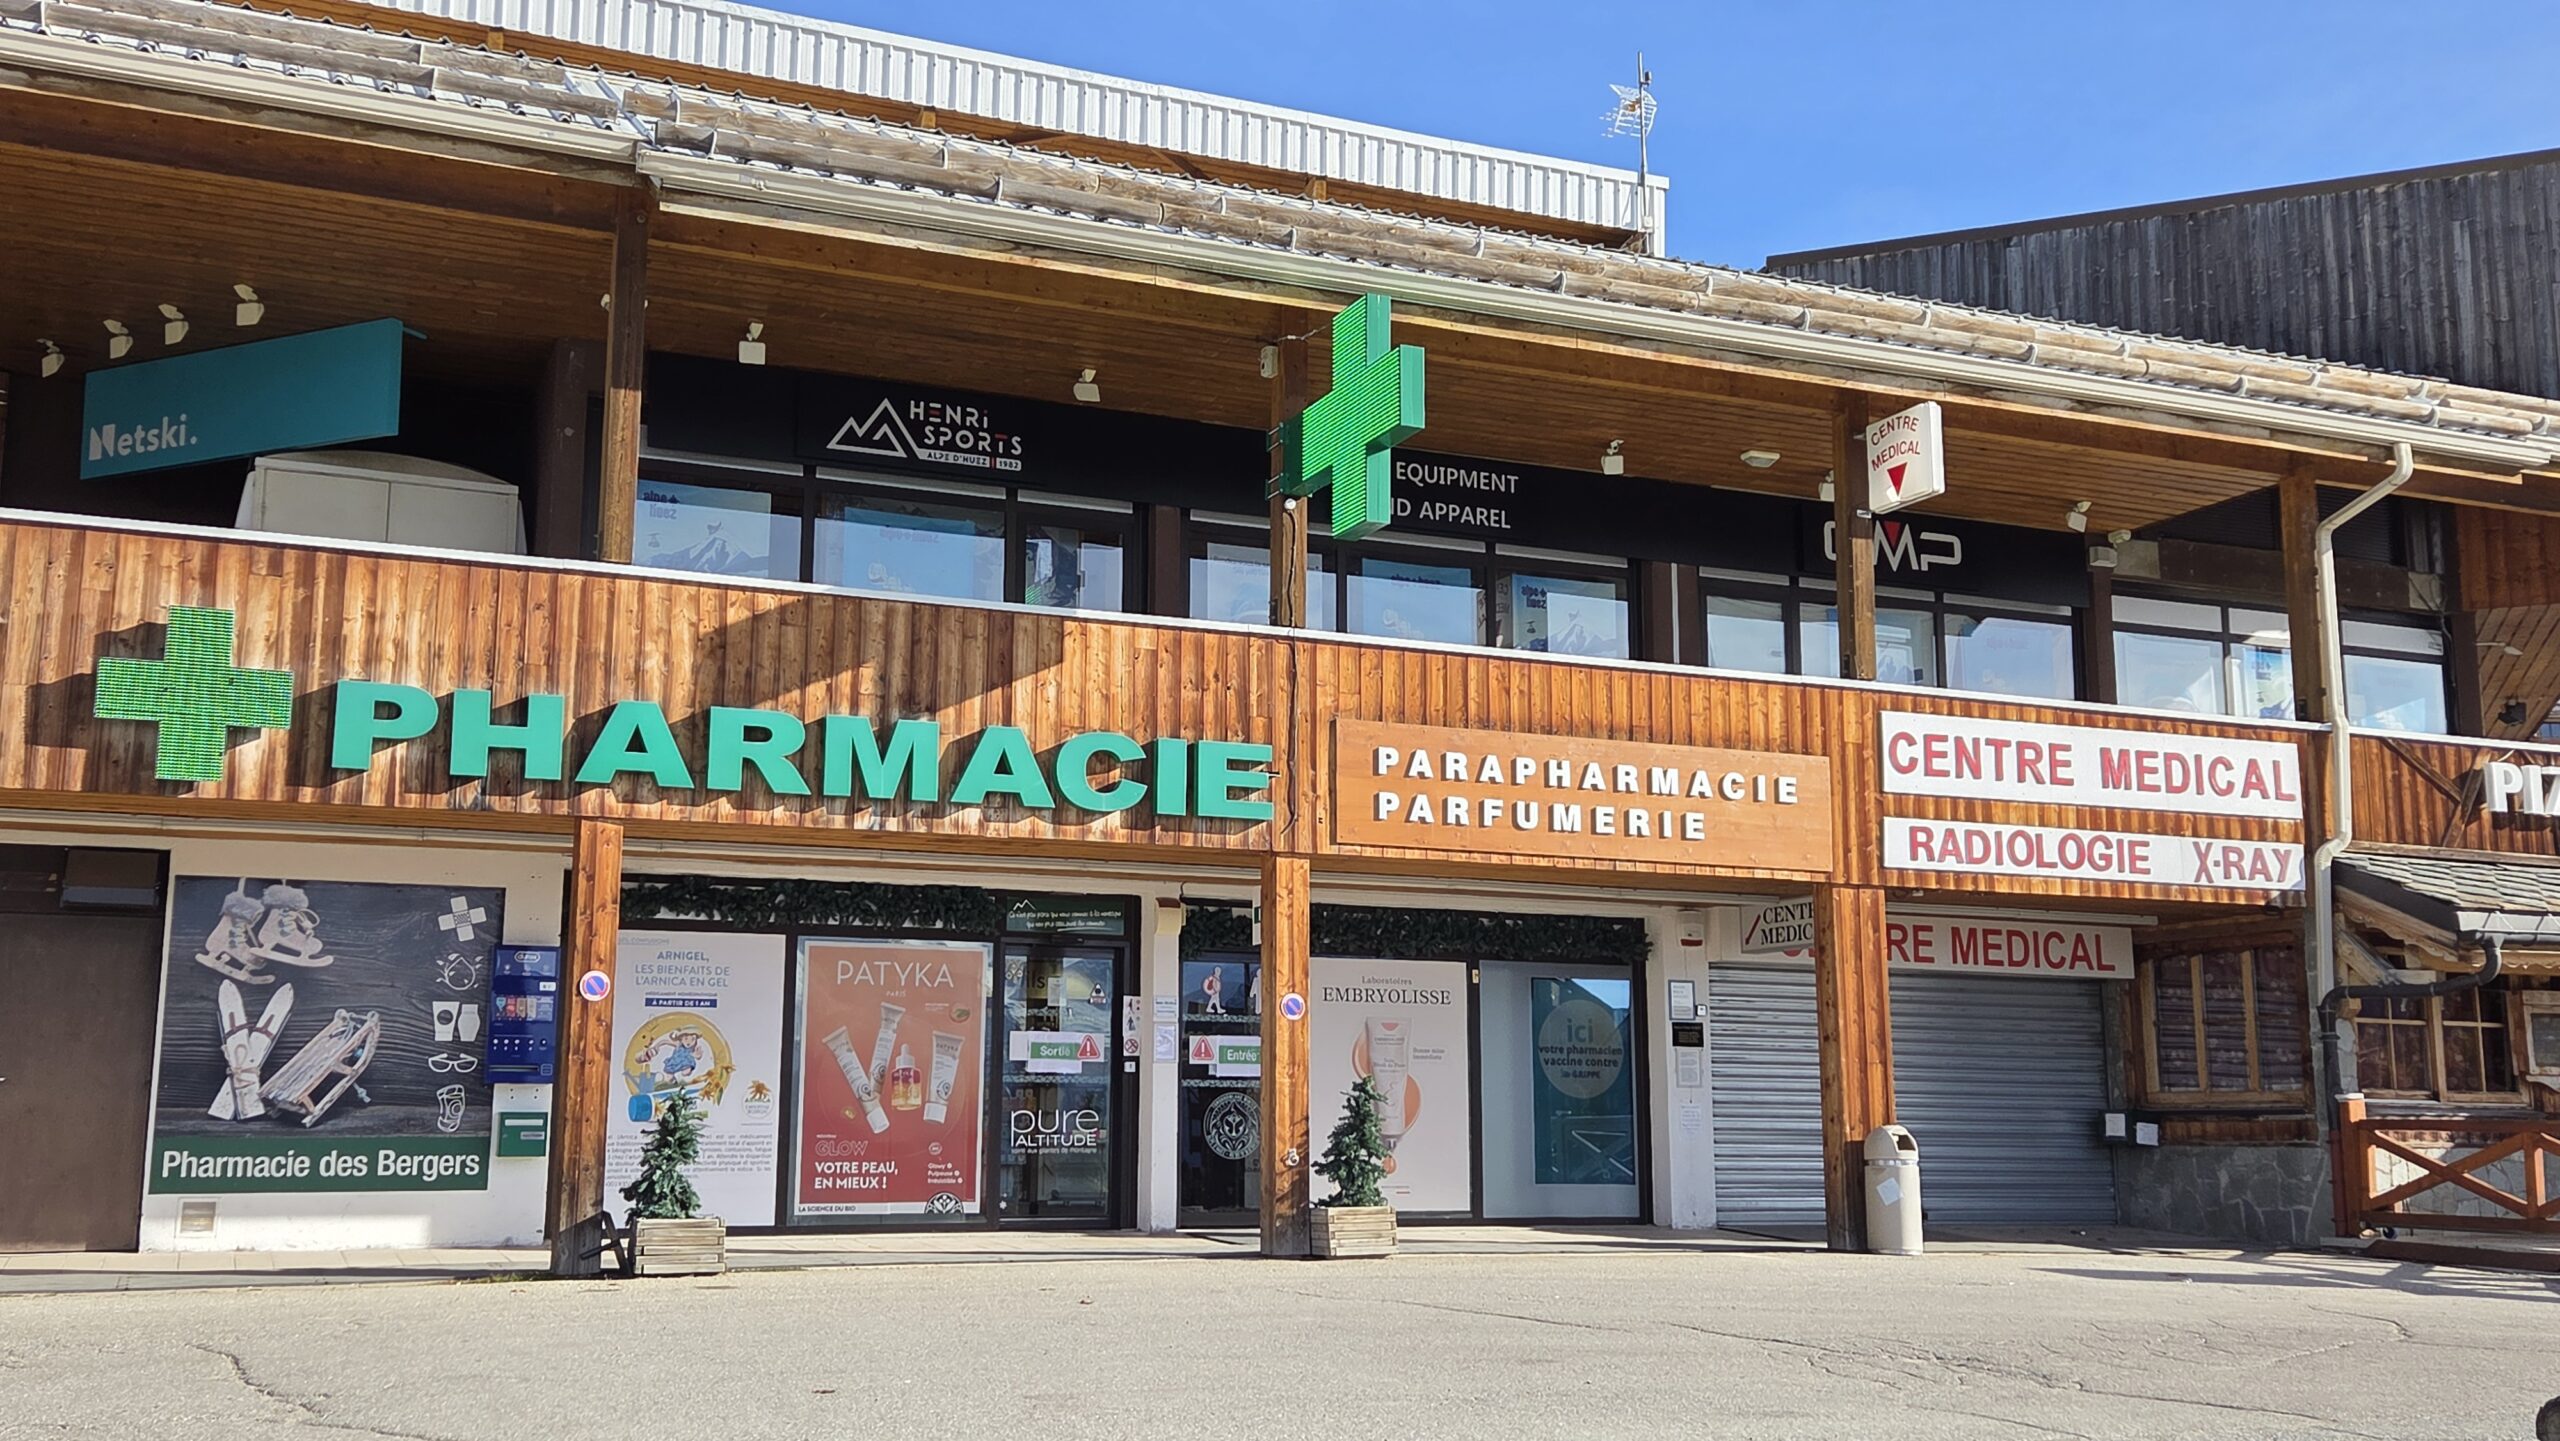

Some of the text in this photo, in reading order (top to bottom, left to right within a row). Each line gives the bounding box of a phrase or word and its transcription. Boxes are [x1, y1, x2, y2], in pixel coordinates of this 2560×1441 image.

[88, 415, 198, 461] Netski.
[924, 425, 1022, 455] SPORTS
[1871, 415, 1919, 447] CENTRE
[927, 451, 950, 461] ALPE
[952, 454, 987, 466] D'HUEZ
[1871, 439, 1921, 471] MEDICAL
[1396, 461, 1519, 494] EQUIPMENT
[1419, 501, 1511, 529] APPAREL
[1824, 520, 1962, 572] MP
[331, 679, 1274, 820] PHARMACIE
[1374, 746, 1798, 804] PARAPHARMACIE
[1889, 731, 2296, 802] CENTRE MEDICAL
[1374, 792, 1705, 840] PARFUMERIE
[1909, 826, 2151, 875] RADIOLOGIE
[1763, 902, 1813, 925] CENT
[1760, 923, 1813, 945] MEDIC
[1951, 925, 2116, 971] MEDICAL
[635, 964, 730, 976] LES BIENFAITS DE
[657, 951, 710, 962] ARNIGEL,
[636, 976, 729, 987] L'ARNICA EN GEL
[837, 960, 954, 988] PATYKA
[1362, 976, 1412, 985] Laboratoires
[1322, 987, 1452, 1005] EMBRYOLISSE
[1567, 1018, 1593, 1043] ici
[1539, 1045, 1623, 1056] votre pharmacien
[1543, 1057, 1619, 1067] vaccine contre
[1011, 1109, 1099, 1147] pure
[1015, 1134, 1097, 1146] ALTITUDE
[815, 1140, 868, 1156] GLOW
[162, 1150, 480, 1182] Pharmacie des Bergers
[815, 1160, 898, 1175] VOTRE PEAU,
[814, 1177, 832, 1189] EN
[836, 1176, 879, 1189] MIEUX
